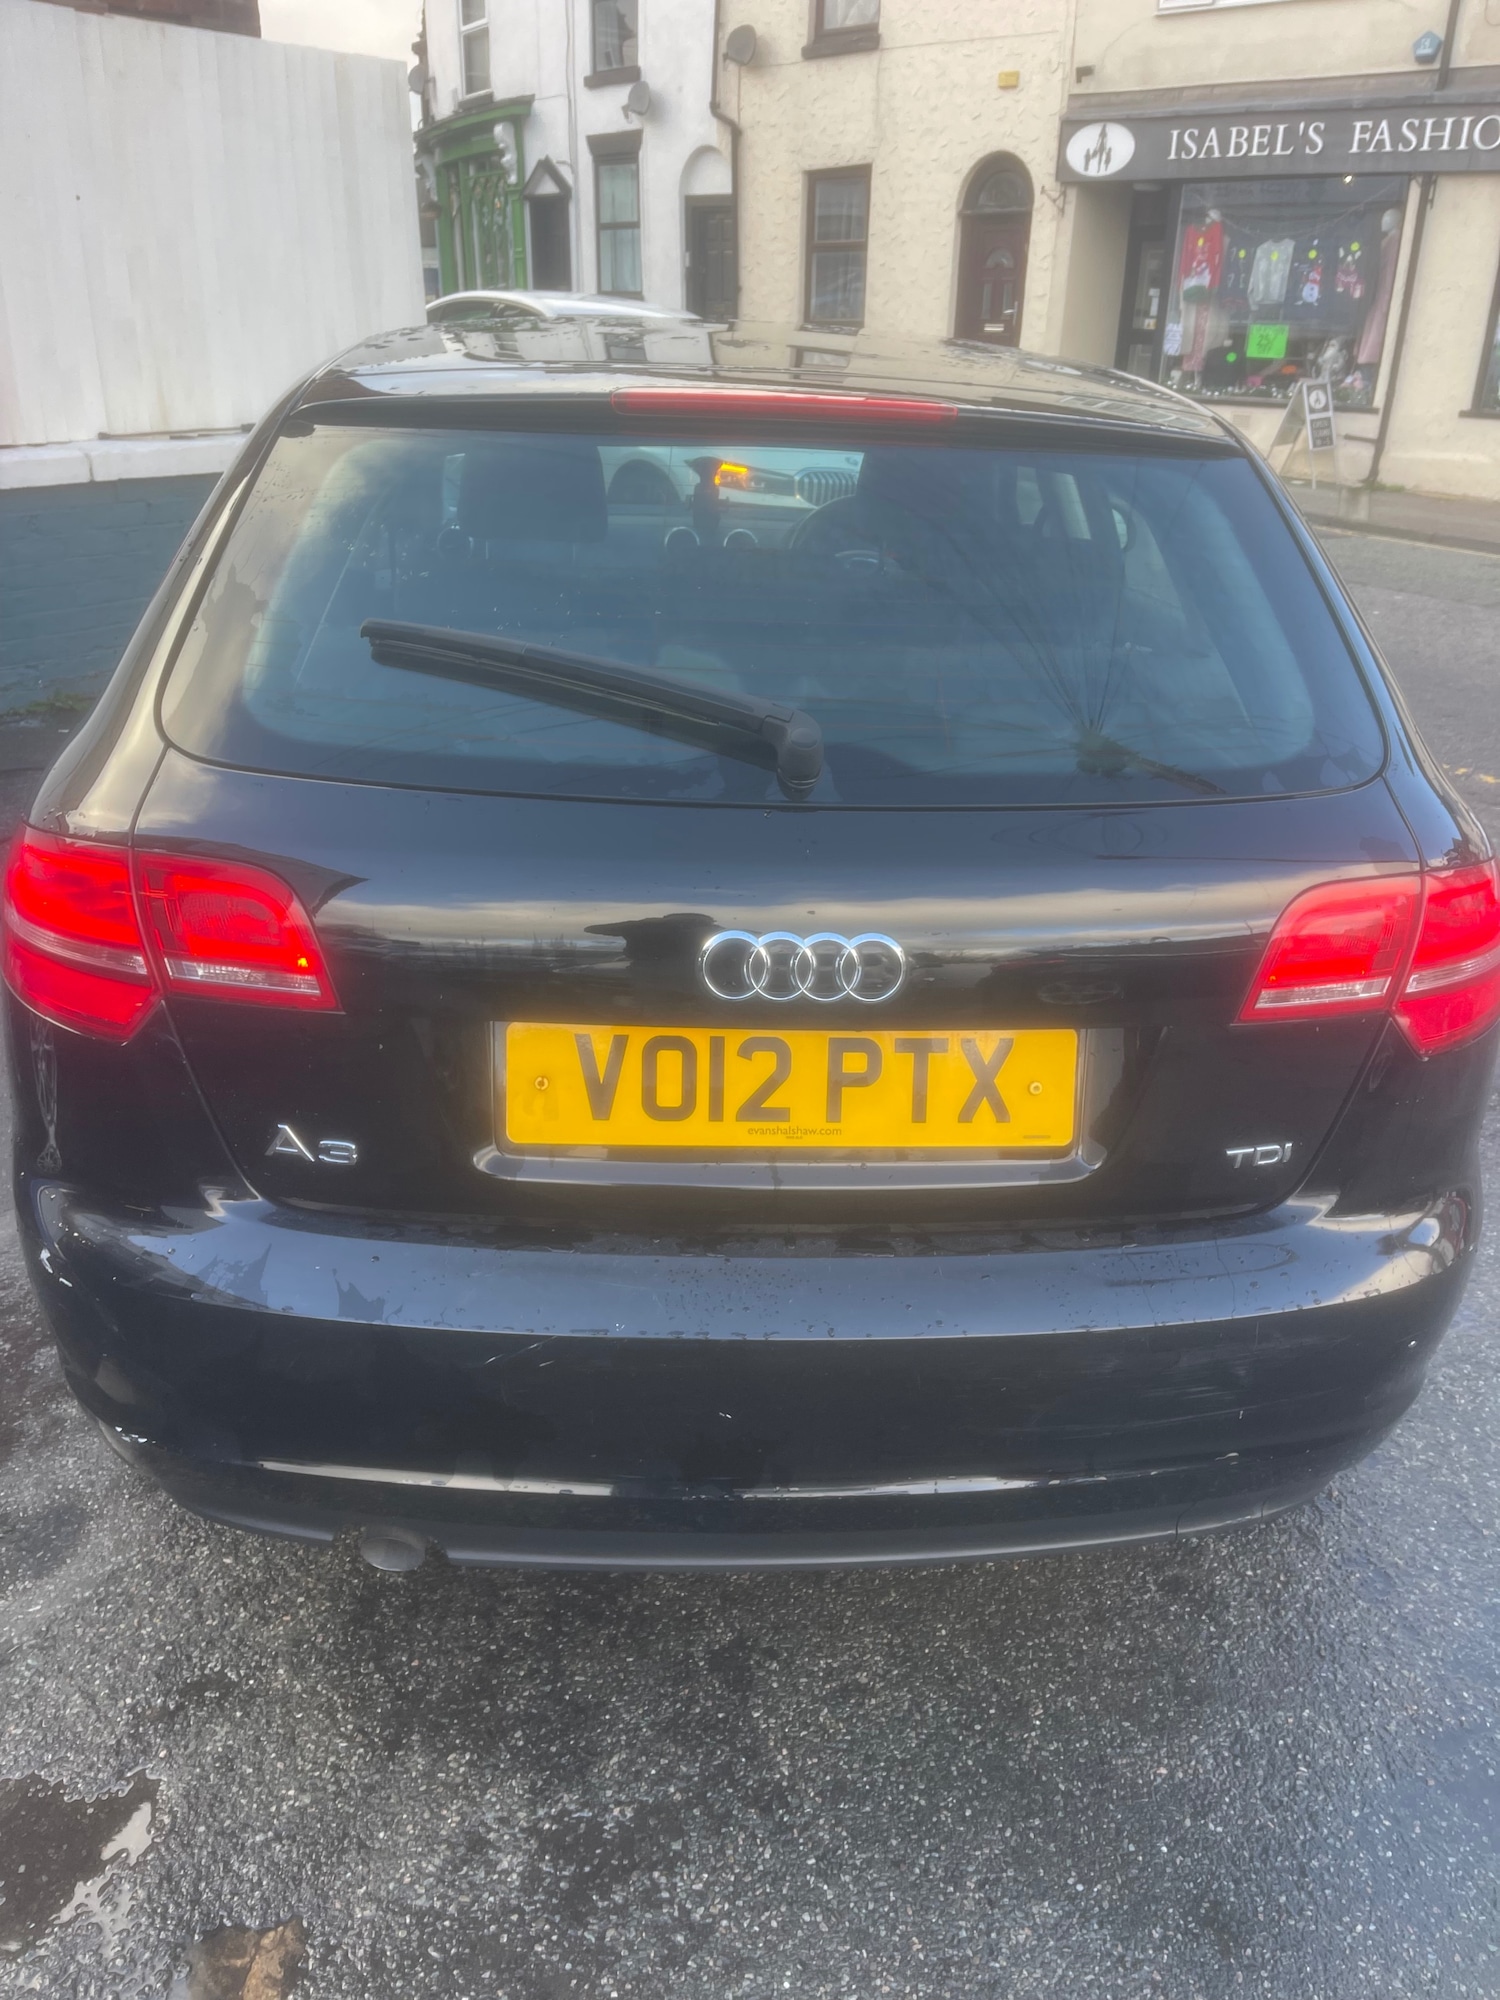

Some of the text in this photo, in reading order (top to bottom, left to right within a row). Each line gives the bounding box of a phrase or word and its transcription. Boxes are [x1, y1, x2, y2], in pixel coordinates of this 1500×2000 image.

[1168, 114, 1500, 160] ISABEL'S FASHIO
[574, 1034, 1014, 1123] VO12 PTX
[265, 1124, 357, 1165] A3
[747, 1126, 842, 1136] evanshalshaw.com
[1225, 1141, 1293, 1169] TDI
